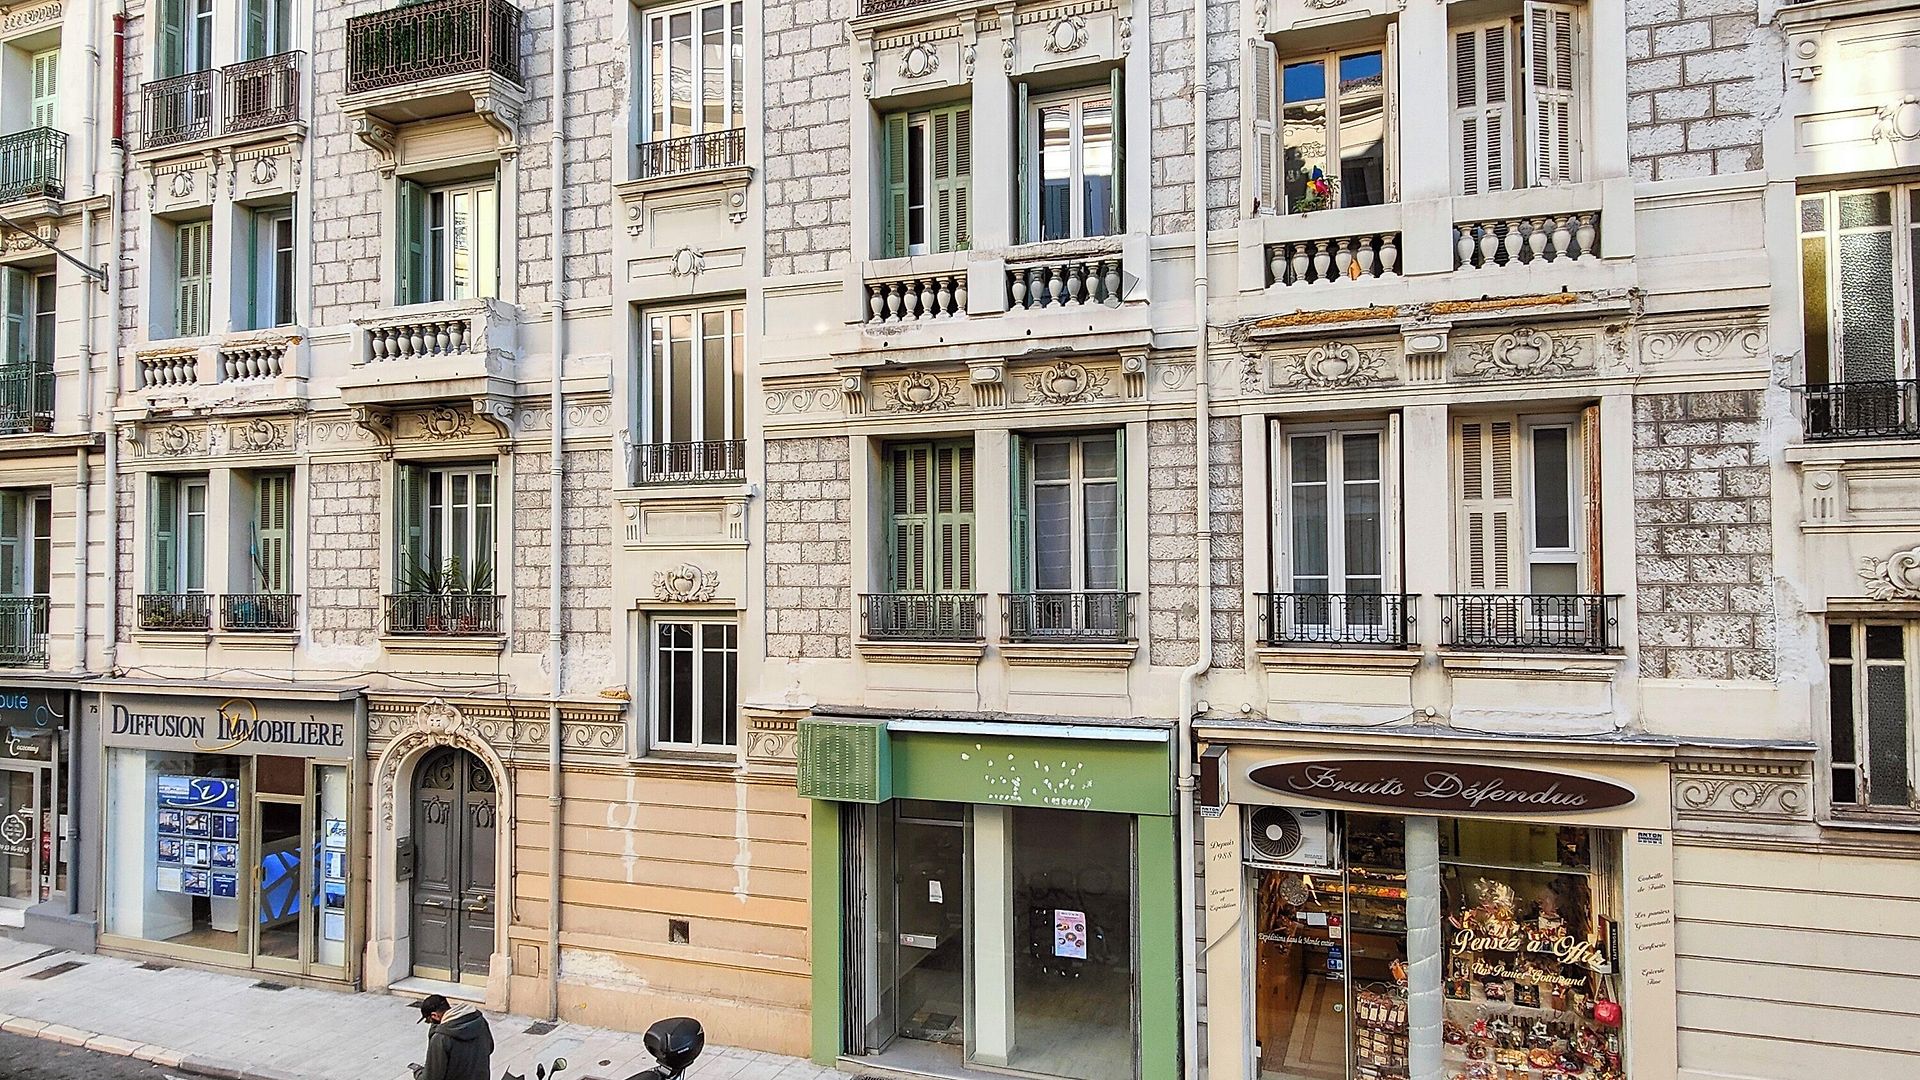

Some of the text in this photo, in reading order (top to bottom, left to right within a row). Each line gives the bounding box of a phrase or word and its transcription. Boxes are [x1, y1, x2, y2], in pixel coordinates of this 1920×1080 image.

[89, 705, 98, 713] 75
[111, 704, 205, 738] DIFFUSION
[1288, 765, 1588, 808] Fruits Défendus
[1210, 840, 1235, 849] Depuis
[1213, 851, 1233, 861] 1988
[1648, 883, 1666, 891] Fruits
[1647, 909, 1670, 919] paniers
[1452, 929, 1521, 955] Pensez
[1491, 964, 1527, 979] Panier
[1531, 969, 1587, 986] Gourmand
